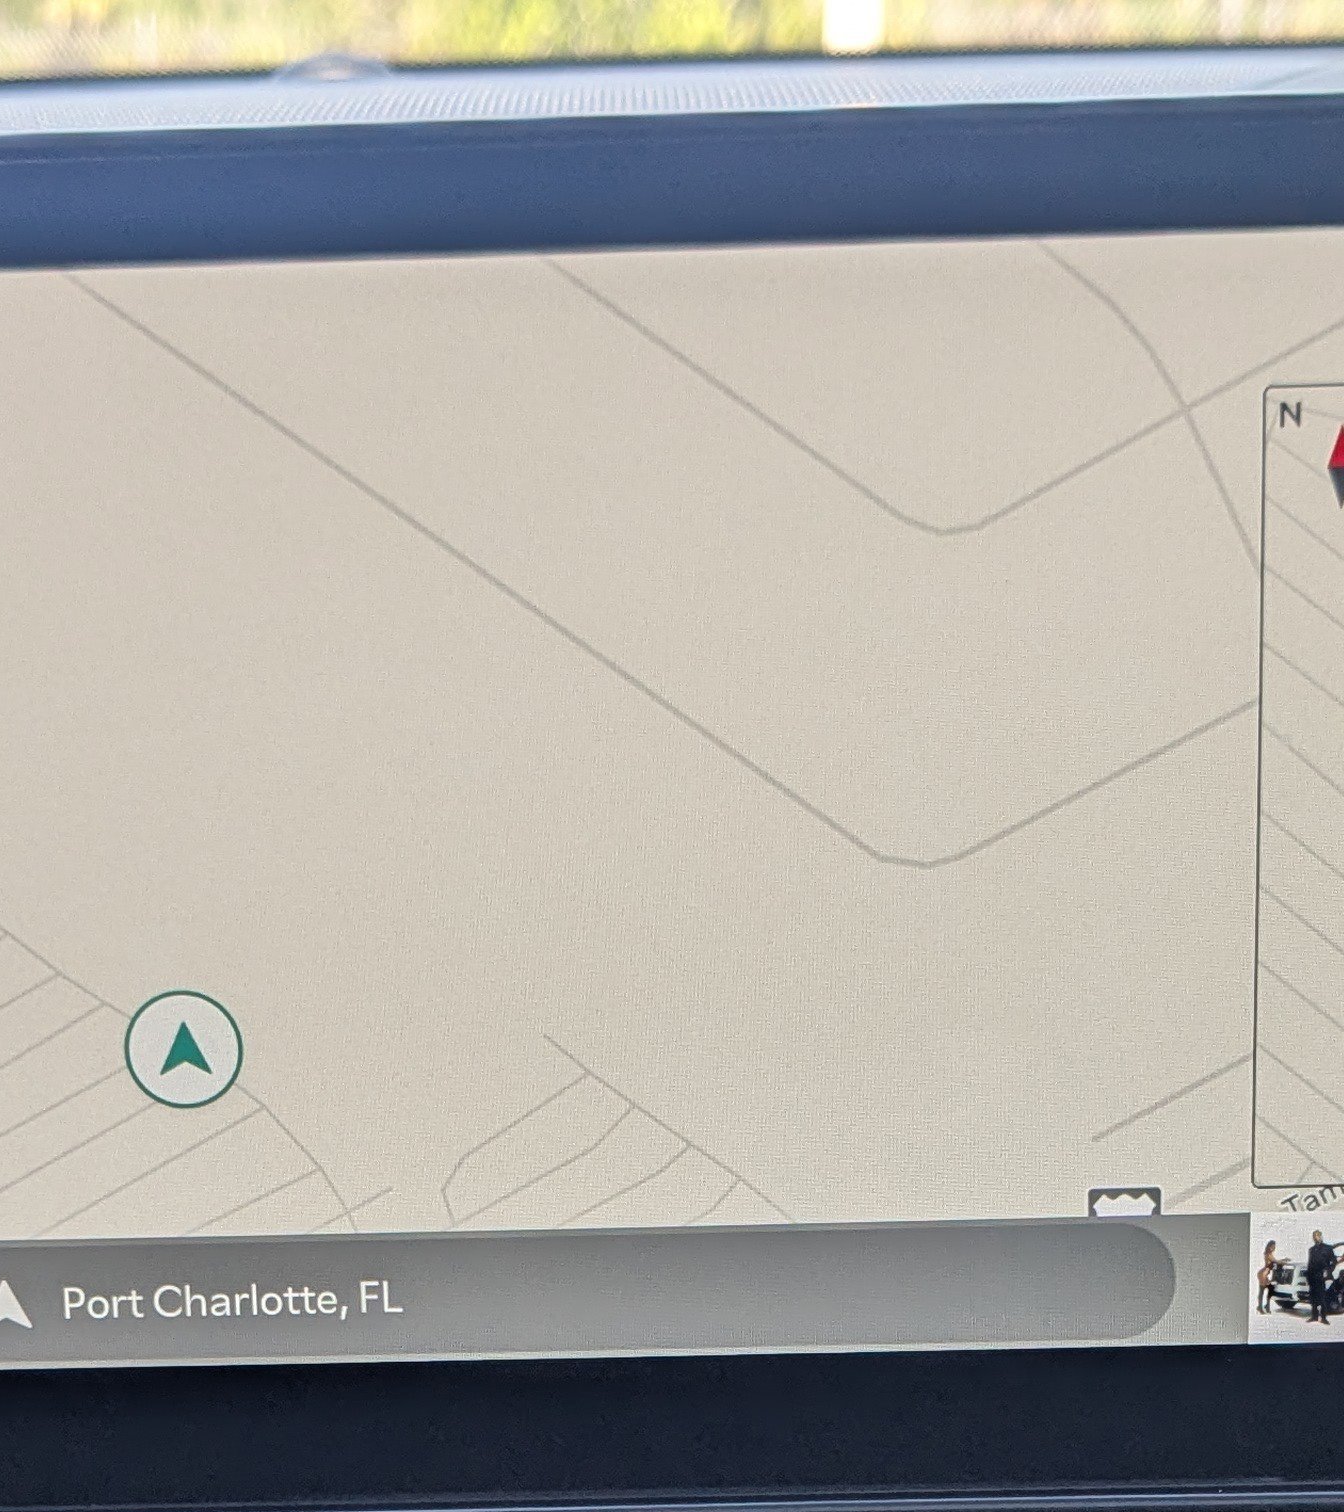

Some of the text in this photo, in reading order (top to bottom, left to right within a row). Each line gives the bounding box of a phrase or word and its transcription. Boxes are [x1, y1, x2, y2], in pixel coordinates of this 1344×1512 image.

[1279, 401, 1303, 428] N
[62, 1280, 405, 1321] Port Charlotte, FL
